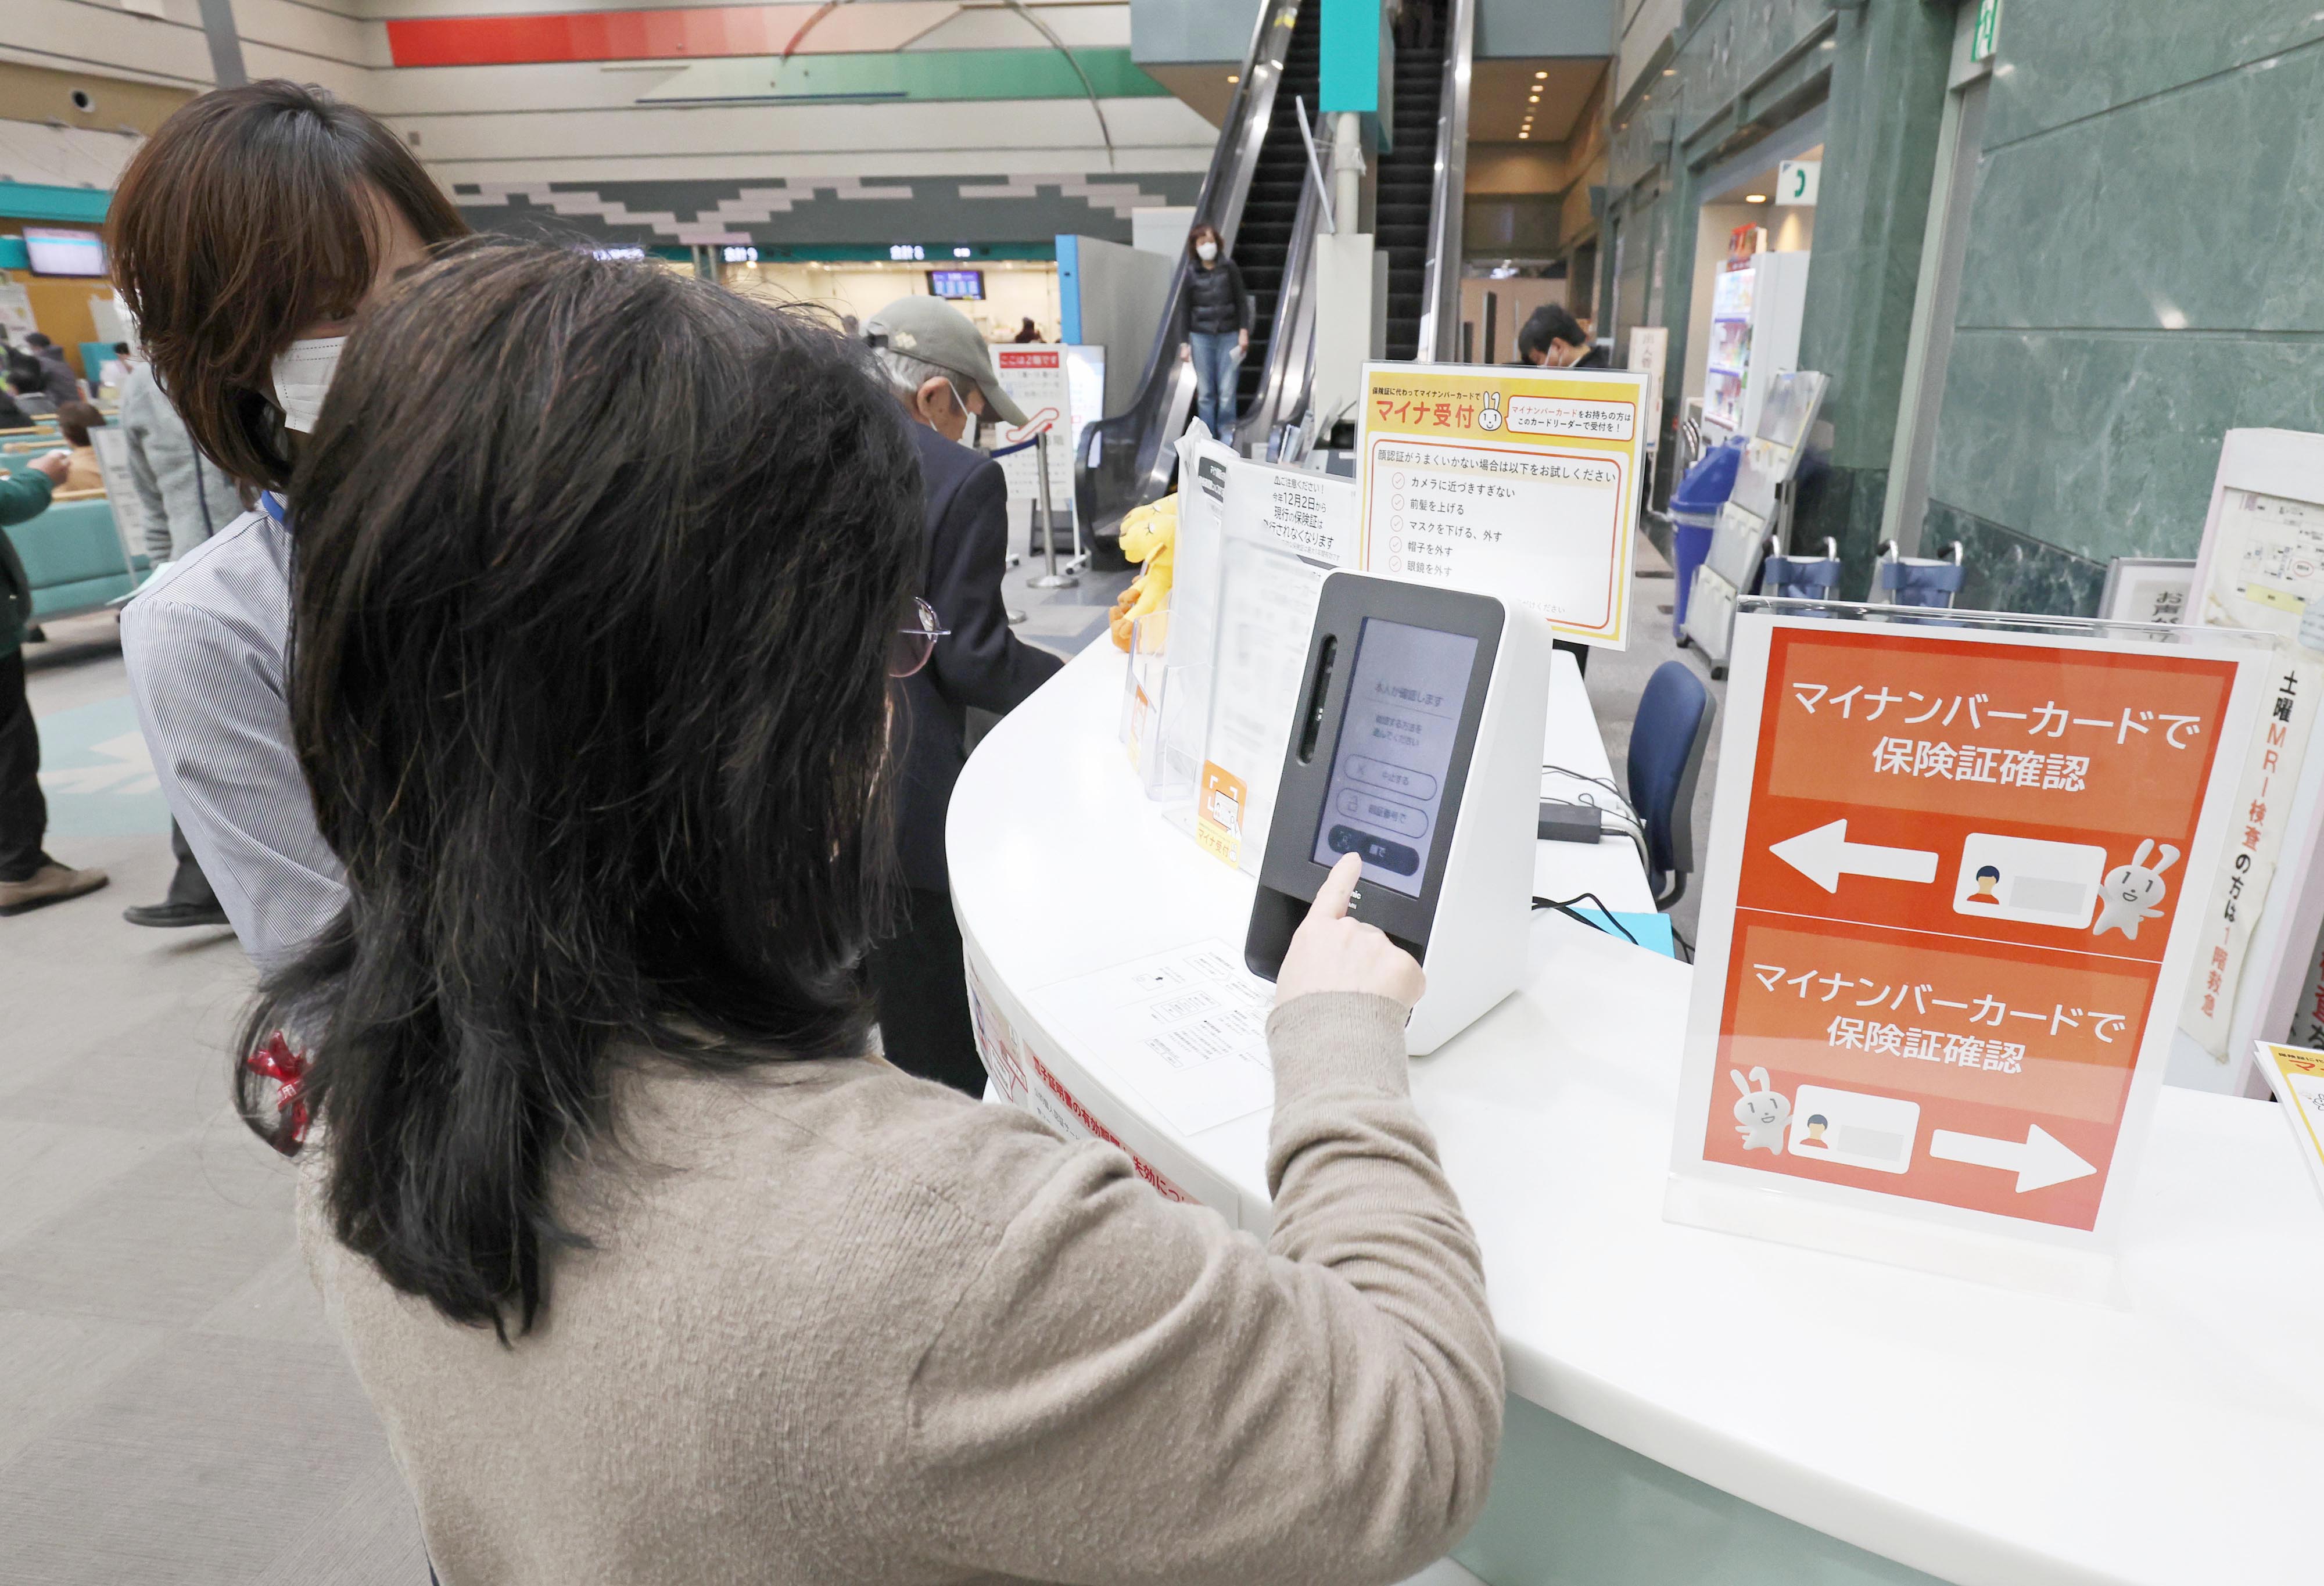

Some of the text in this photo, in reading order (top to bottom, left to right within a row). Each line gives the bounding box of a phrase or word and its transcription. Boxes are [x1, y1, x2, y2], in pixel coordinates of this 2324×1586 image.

[1372, 387, 1481, 401] 保険証に代わってマイナンバーカードで
[1376, 400, 1475, 429] マイナ受付
[1512, 406, 1631, 422] マイナンバーカードをお持ちの方は
[1518, 418, 1620, 432] このカードリーダーで受付を！
[1378, 449, 1616, 483] 顔認証がうまくいかない場合は以下をお試しください
[1411, 476, 1515, 498] カメラに近づきすぎない
[1273, 492, 1326, 513] 今年12月2日から
[1410, 498, 1464, 515] 前髪を上げる
[1274, 506, 1324, 529] 現行の保険証は
[1409, 521, 1502, 543] マスクを下げる、外す
[1407, 540, 1453, 557] 帽子を外す
[1407, 561, 1452, 577] 眼鏡を外す
[1791, 681, 2201, 750] マイナンバーカードで
[1871, 735, 2090, 794] 保険証確認
[1751, 962, 2127, 1043] マイナンバーカードで
[1826, 1015, 2027, 1075] 保険証確認
